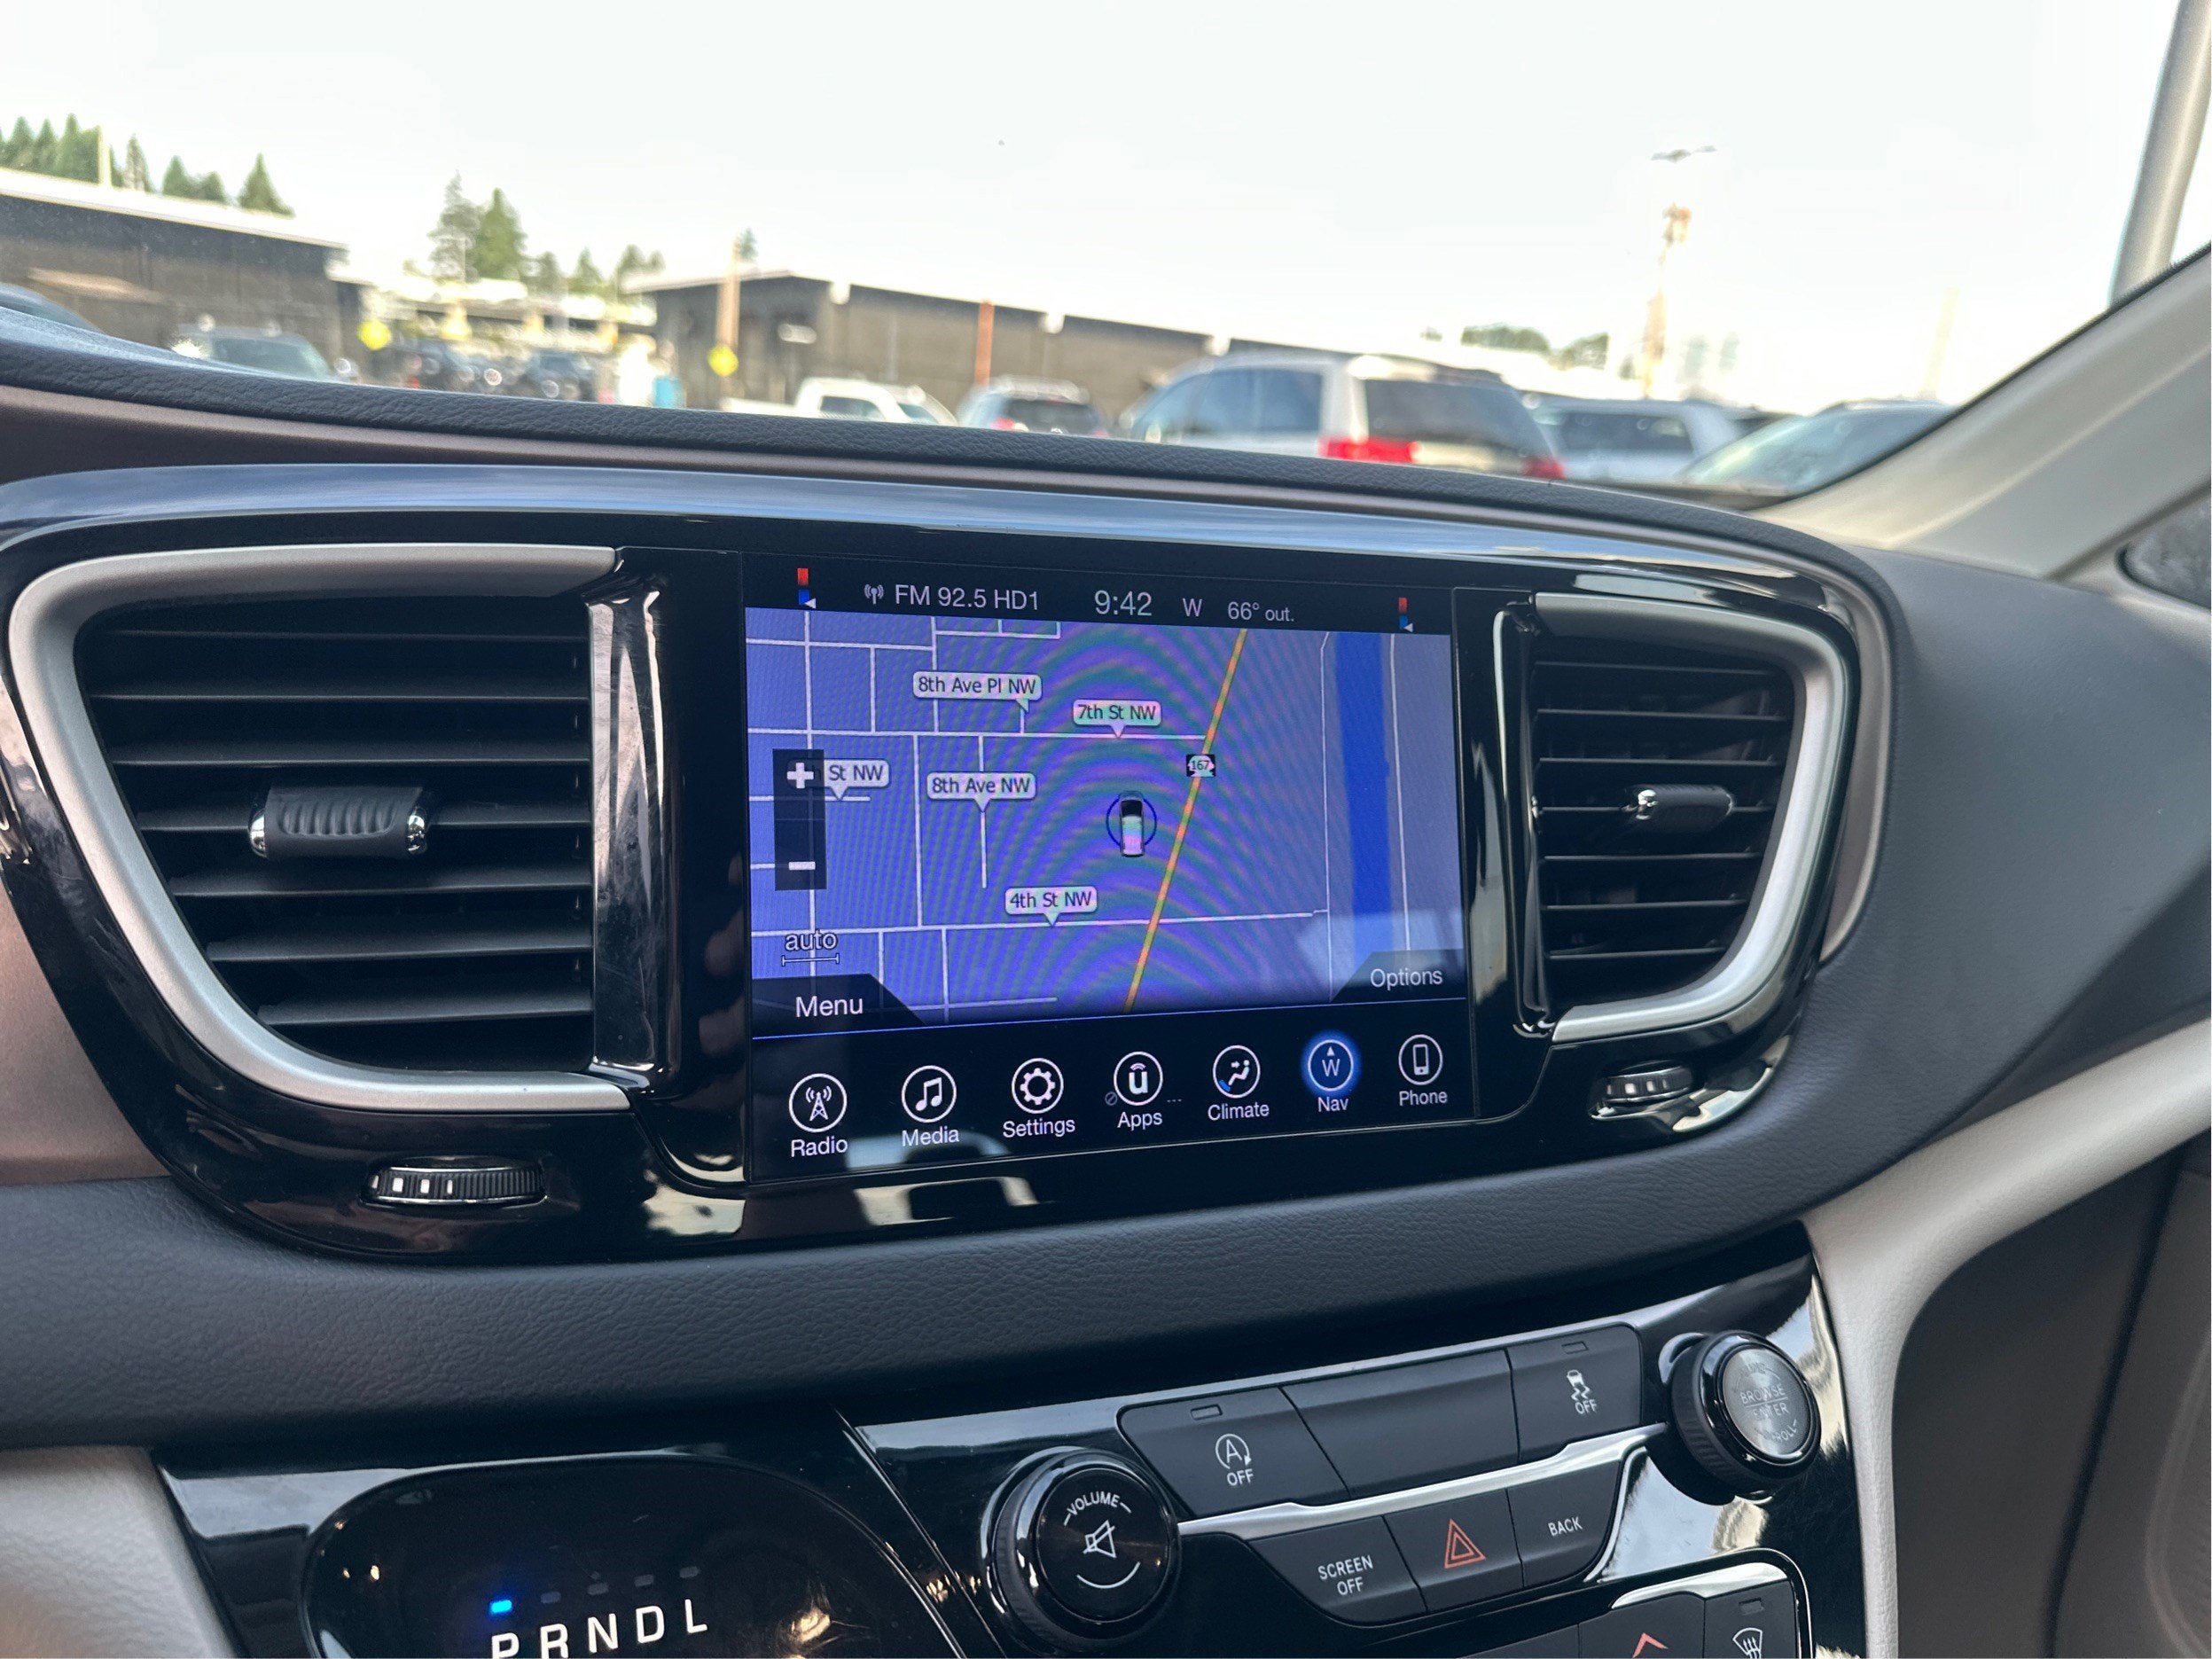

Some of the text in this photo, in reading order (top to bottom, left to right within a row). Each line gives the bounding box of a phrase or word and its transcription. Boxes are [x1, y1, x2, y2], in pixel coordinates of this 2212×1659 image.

[895, 583, 1038, 611] FM 92.5 HD1
[1094, 590, 1153, 616] 9:42
[1182, 598, 1203, 617] W
[1227, 601, 1295, 622] 66° out.
[918, 676, 1036, 694] 8th Ave Pl NW
[1077, 703, 1157, 721] 7th St NW
[828, 764, 847, 781] St
[853, 764, 884, 781] NW
[1192, 760, 1210, 771] 167
[932, 778, 1031, 794] 8th Ave NW
[1010, 890, 1092, 909] 4th St NW
[786, 929, 839, 951] auto
[1370, 967, 1443, 991] Options
[795, 995, 864, 1018] Menu
[1321, 1058, 1340, 1077] W
[1317, 1096, 1349, 1113] Nav
[1398, 1089, 1448, 1107] Phone
[1116, 1111, 1163, 1131] Apps
[1207, 1101, 1270, 1121] Climate
[901, 1125, 960, 1147] Media
[1002, 1117, 1076, 1139] Settings
[790, 1135, 848, 1158] Radio
[1739, 1383, 1786, 1405] BROWSE
[1575, 1398, 1598, 1414] OFF
[1753, 1402, 1790, 1419] ENTER
[1226, 1468, 1255, 1487] OFF
[1067, 1491, 1121, 1516] VOLUME
[1547, 1516, 1583, 1537] BACK
[1317, 1554, 1374, 1581] SCREEN
[1337, 1577, 1364, 1596] OFF
